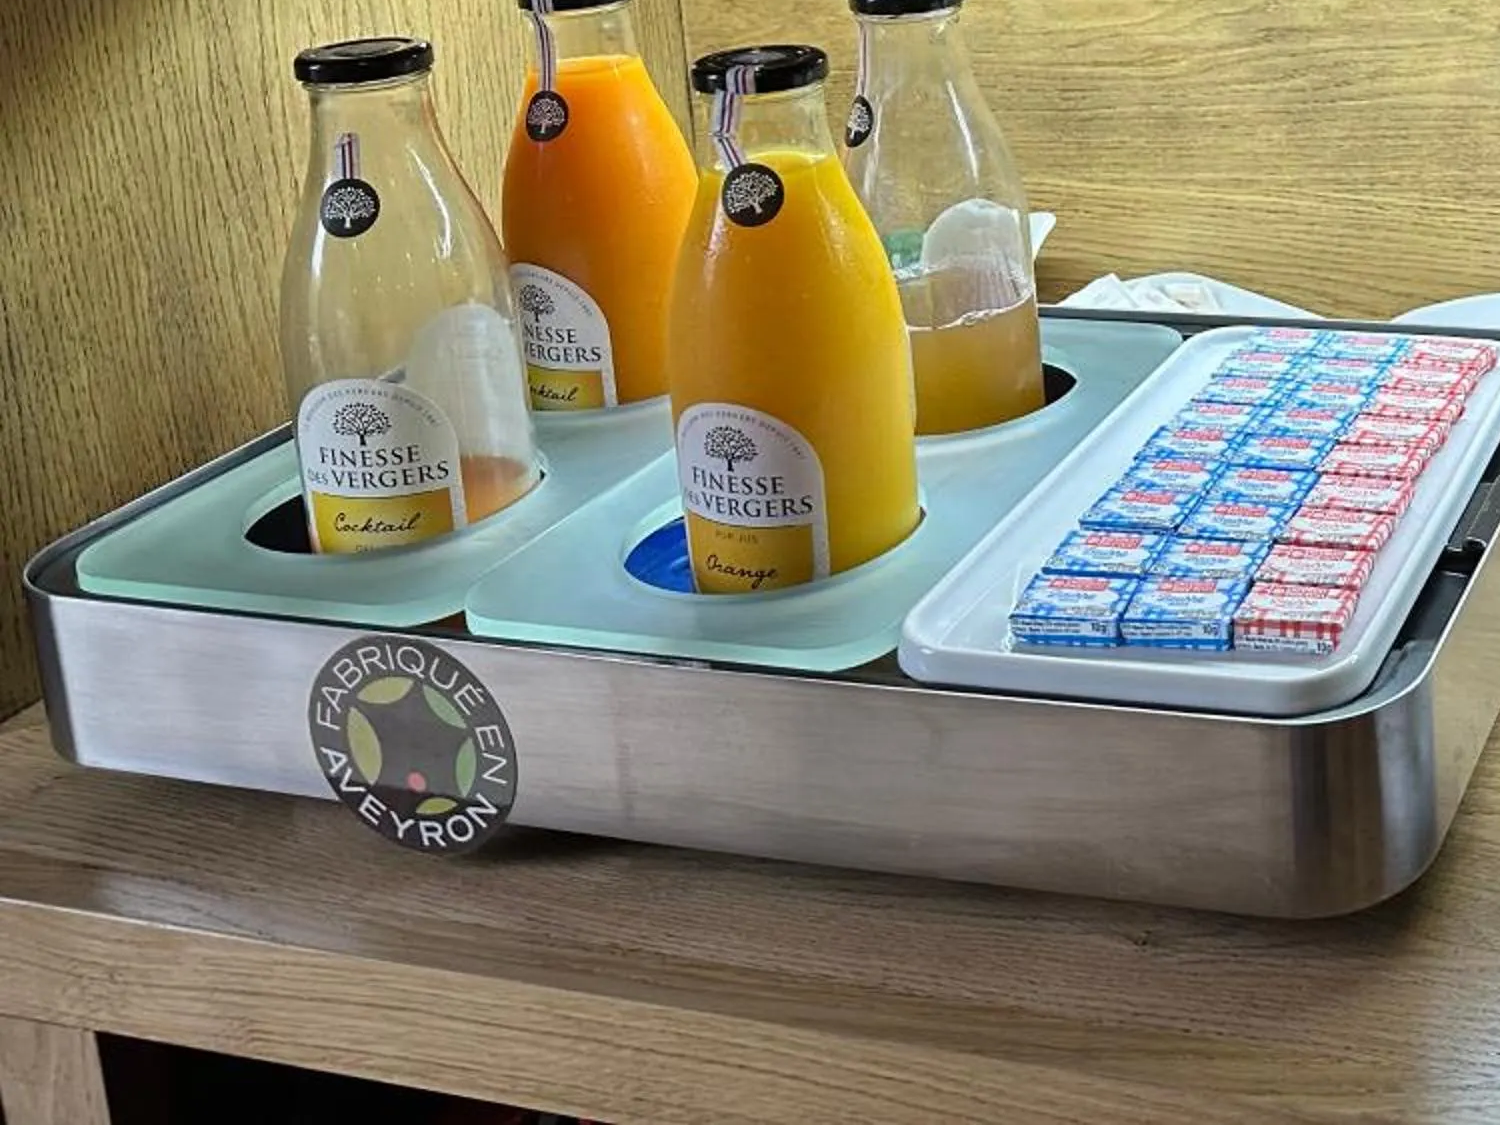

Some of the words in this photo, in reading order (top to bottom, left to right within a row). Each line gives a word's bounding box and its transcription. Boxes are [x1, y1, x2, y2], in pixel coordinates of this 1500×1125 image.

[524, 323, 578, 344] NESSE
[529, 383, 580, 402] cktail
[319, 444, 422, 468] FINESSE
[329, 460, 450, 490] VERGERS
[692, 466, 785, 496] FINESSE
[699, 491, 814, 519] VERGERS
[333, 511, 422, 534] Cocktail
[705, 554, 779, 590] Orange
[316, 643, 487, 731] FABRIQUÉ
[474, 724, 508, 786] EN
[319, 745, 499, 849] AVEYRON
